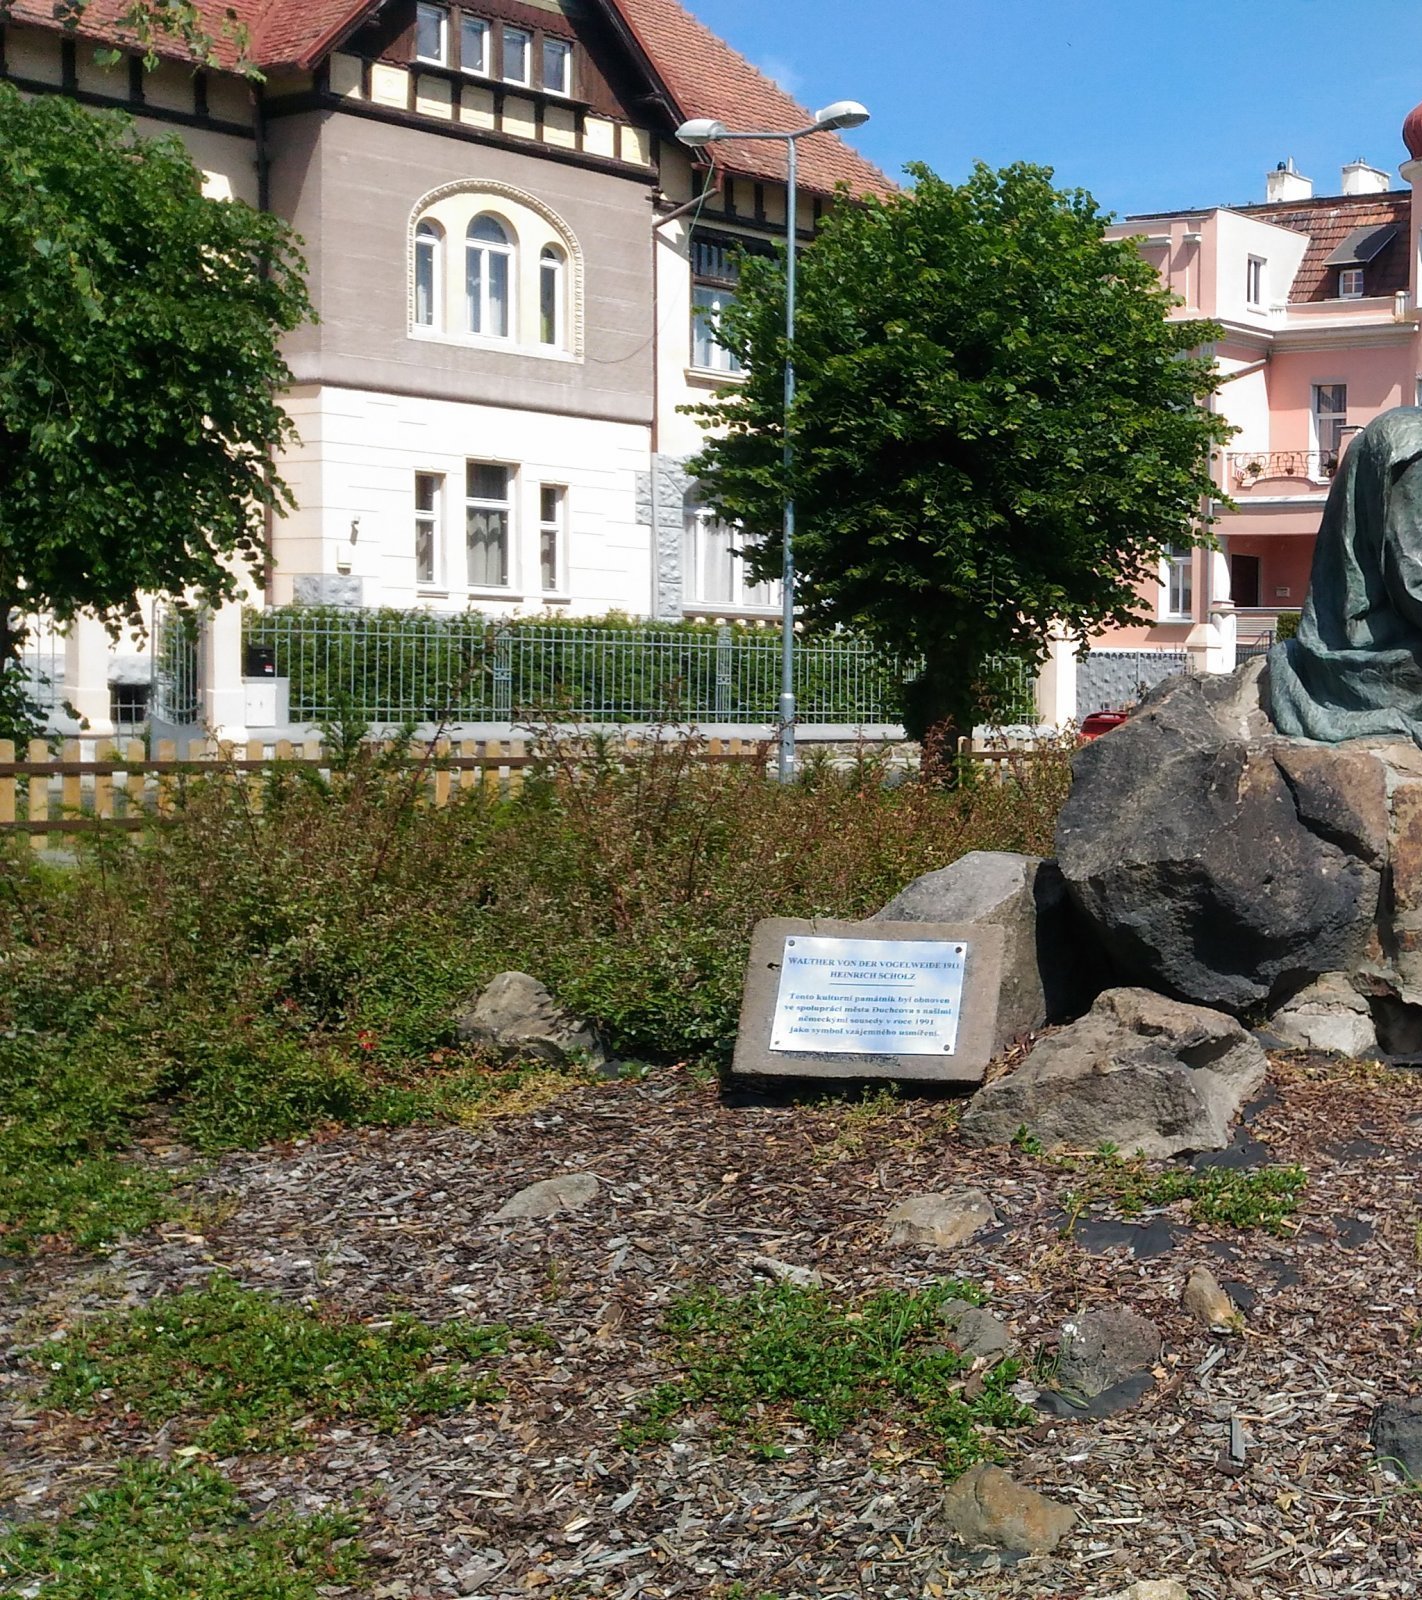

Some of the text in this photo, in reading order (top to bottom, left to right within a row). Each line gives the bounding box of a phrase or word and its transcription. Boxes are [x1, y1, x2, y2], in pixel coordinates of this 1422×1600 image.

[788, 957, 835, 966] WALTHER
[837, 959, 857, 967] VON
[859, 960, 877, 968] DER
[880, 961, 941, 969] VOGELWEIDE
[830, 971, 916, 980] HEINRICH SCHOLZ
[789, 1026, 810, 1034] jako
[811, 1027, 843, 1035] symbol
